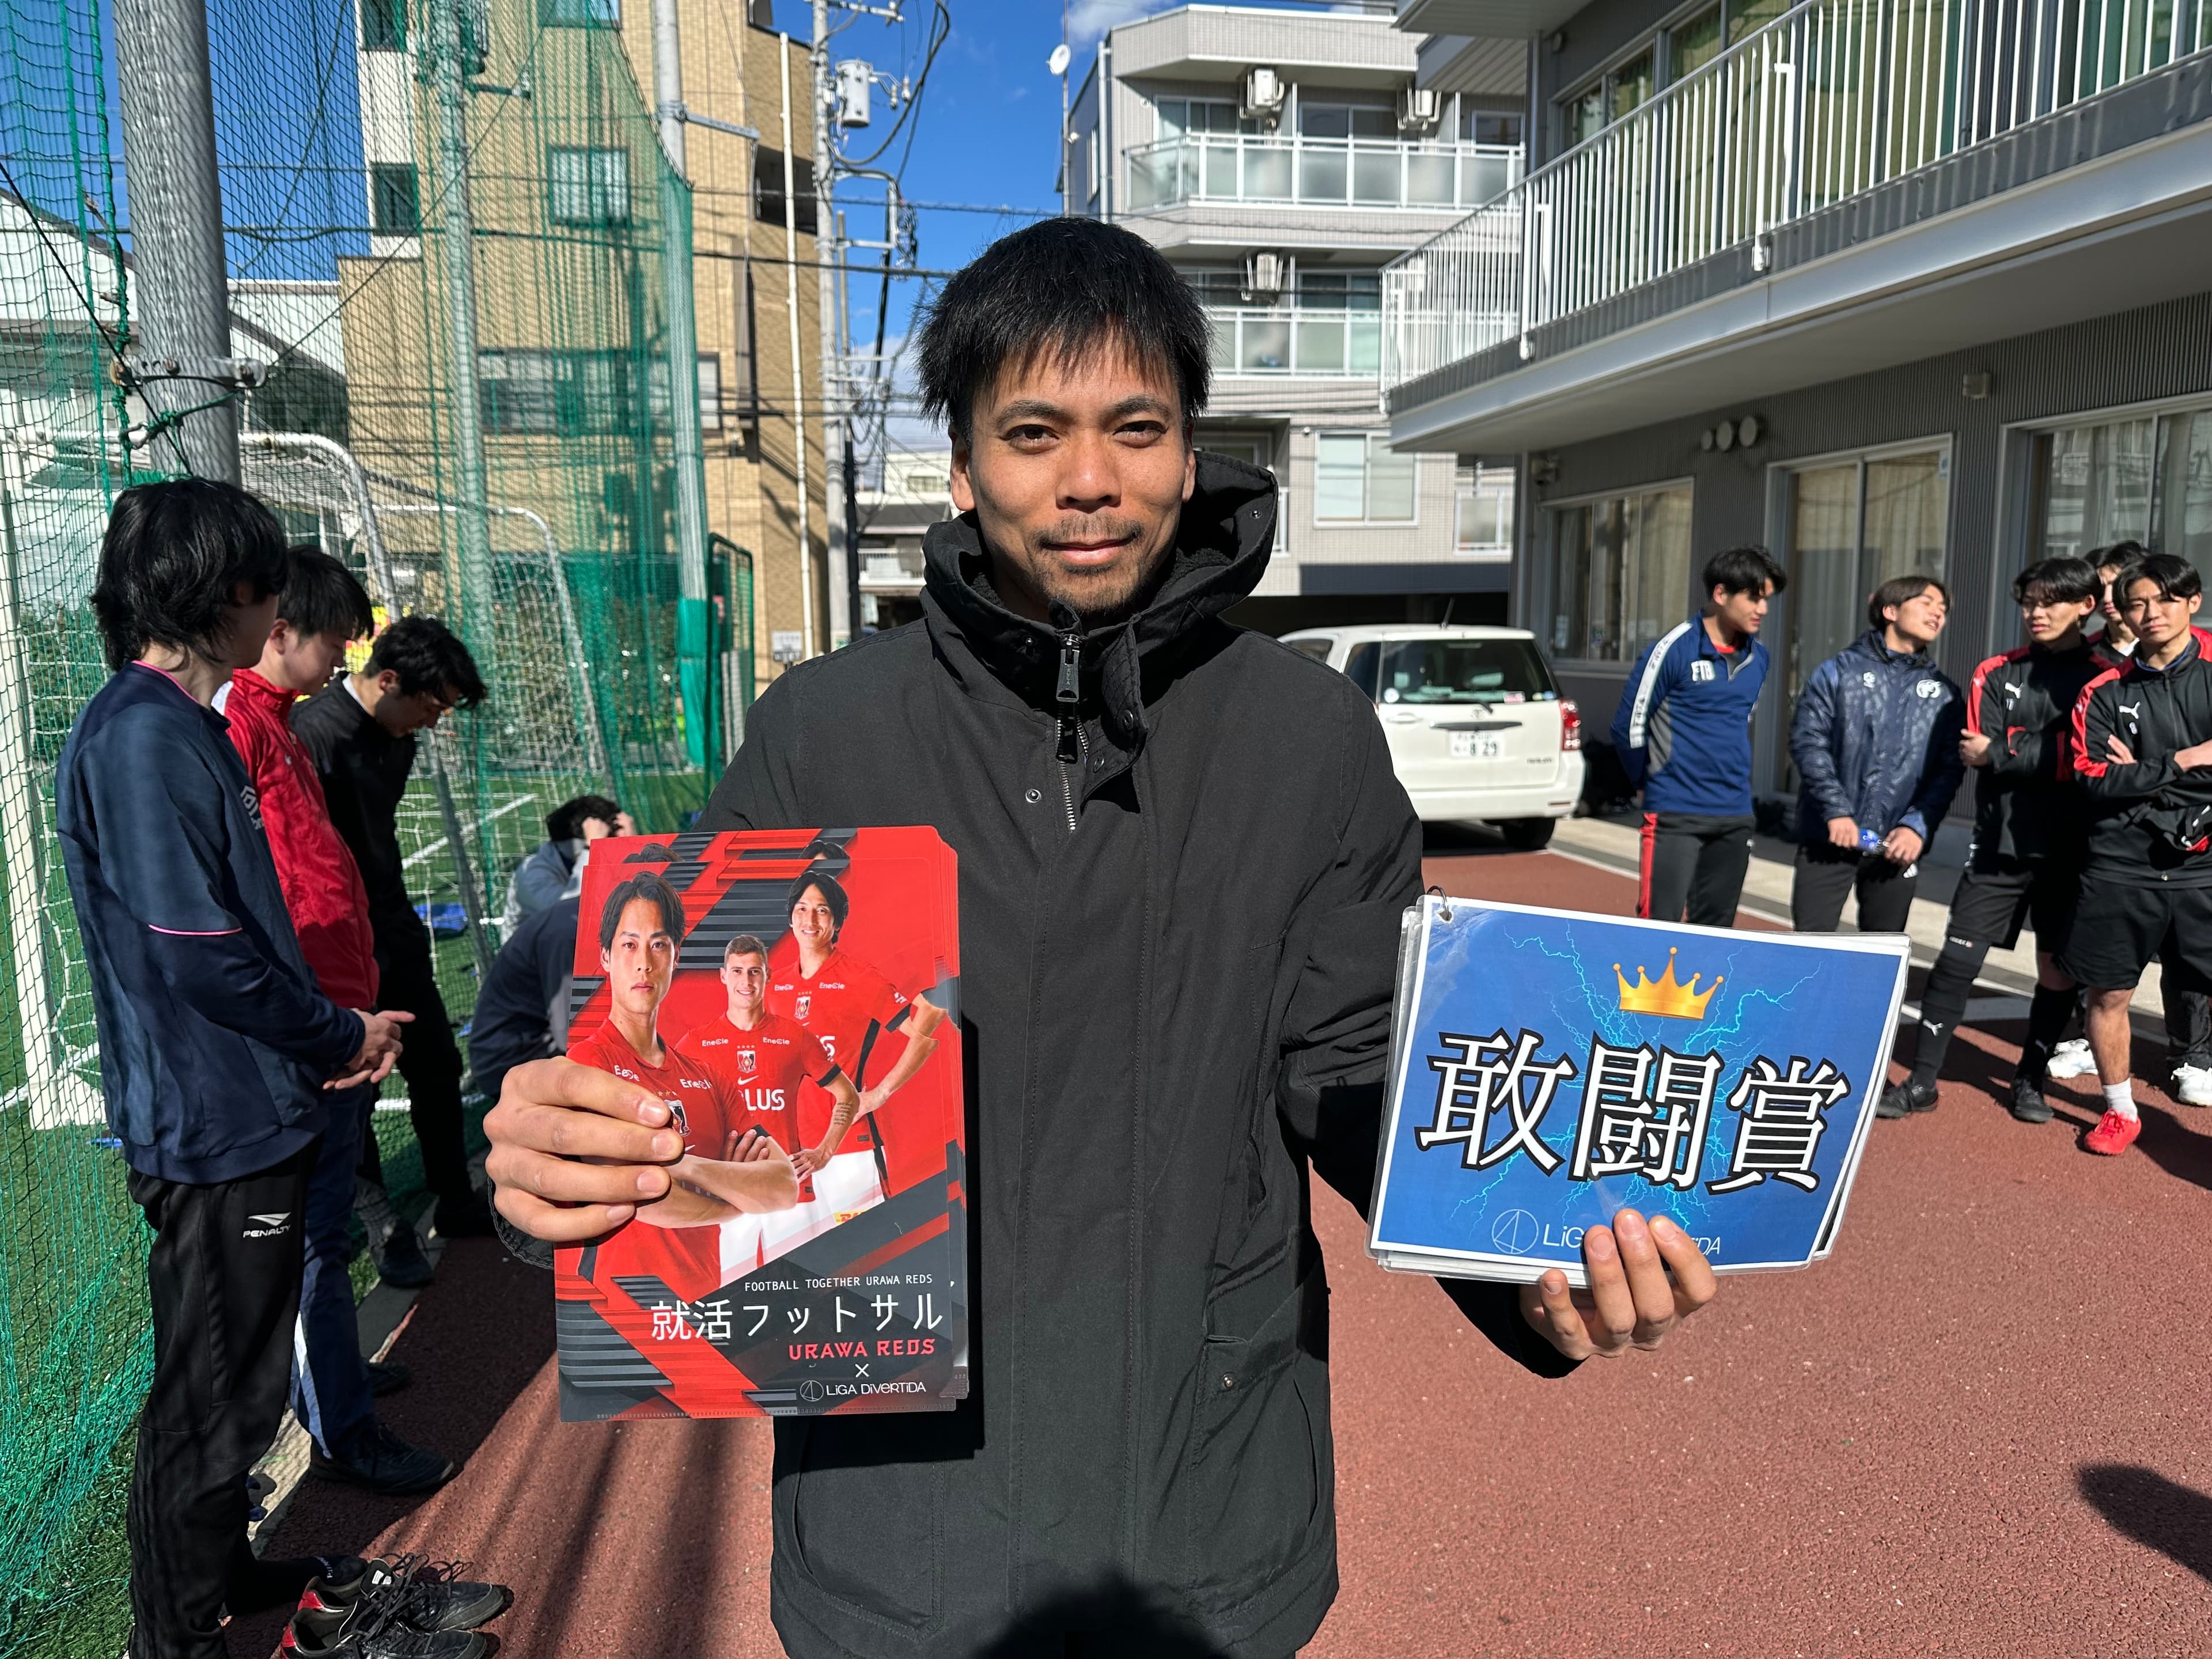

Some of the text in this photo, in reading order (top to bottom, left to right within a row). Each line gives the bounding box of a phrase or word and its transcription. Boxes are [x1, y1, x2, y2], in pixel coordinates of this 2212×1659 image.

[1414, 1028, 1850, 1195] 敢闘賞
[243, 1224, 291, 1238] PENALTY
[745, 1274, 933, 1291] FOOTBALL TOGETHER URAWA REDS
[650, 1293, 943, 1342] 就活フットサル
[789, 1338, 936, 1360] URAWA REDS
